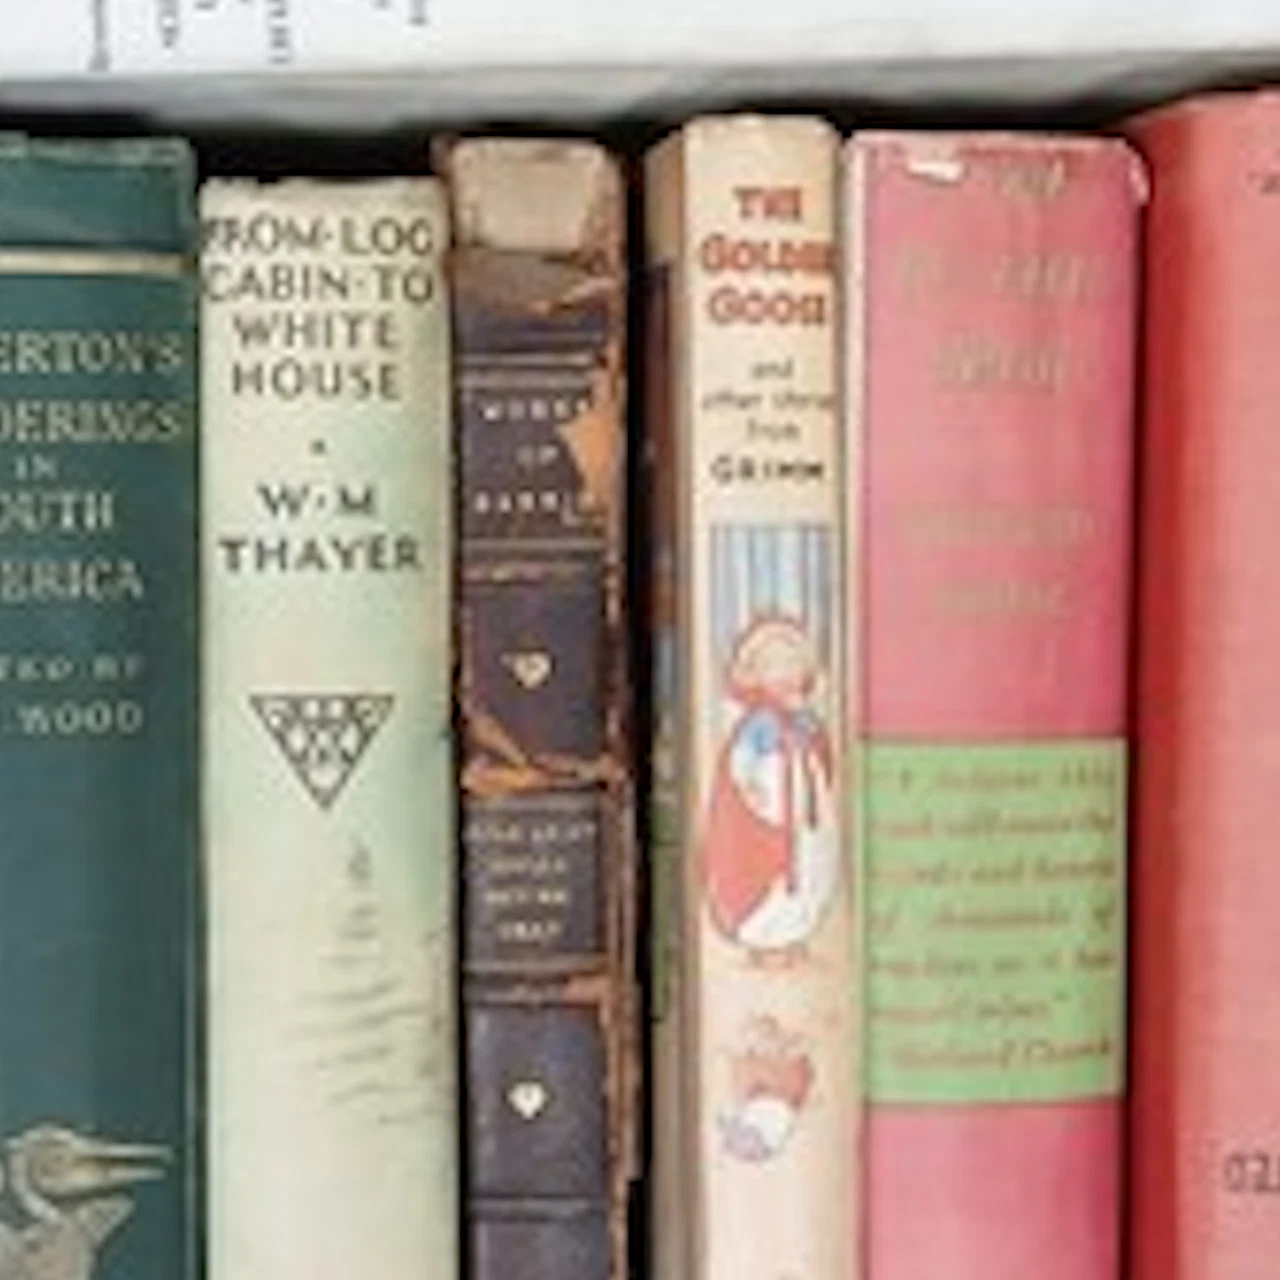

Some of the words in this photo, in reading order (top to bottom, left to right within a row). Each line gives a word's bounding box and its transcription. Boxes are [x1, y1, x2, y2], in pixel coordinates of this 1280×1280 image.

[733, 185, 803, 220] THE
[708, 285, 826, 326] GOOSE
[232, 311, 400, 350] WHITE
[232, 360, 402, 401] HOUSE
[709, 452, 825, 484] GRIMM
[218, 535, 426, 574] THAYER
[17, 700, 145, 734] WOOD
